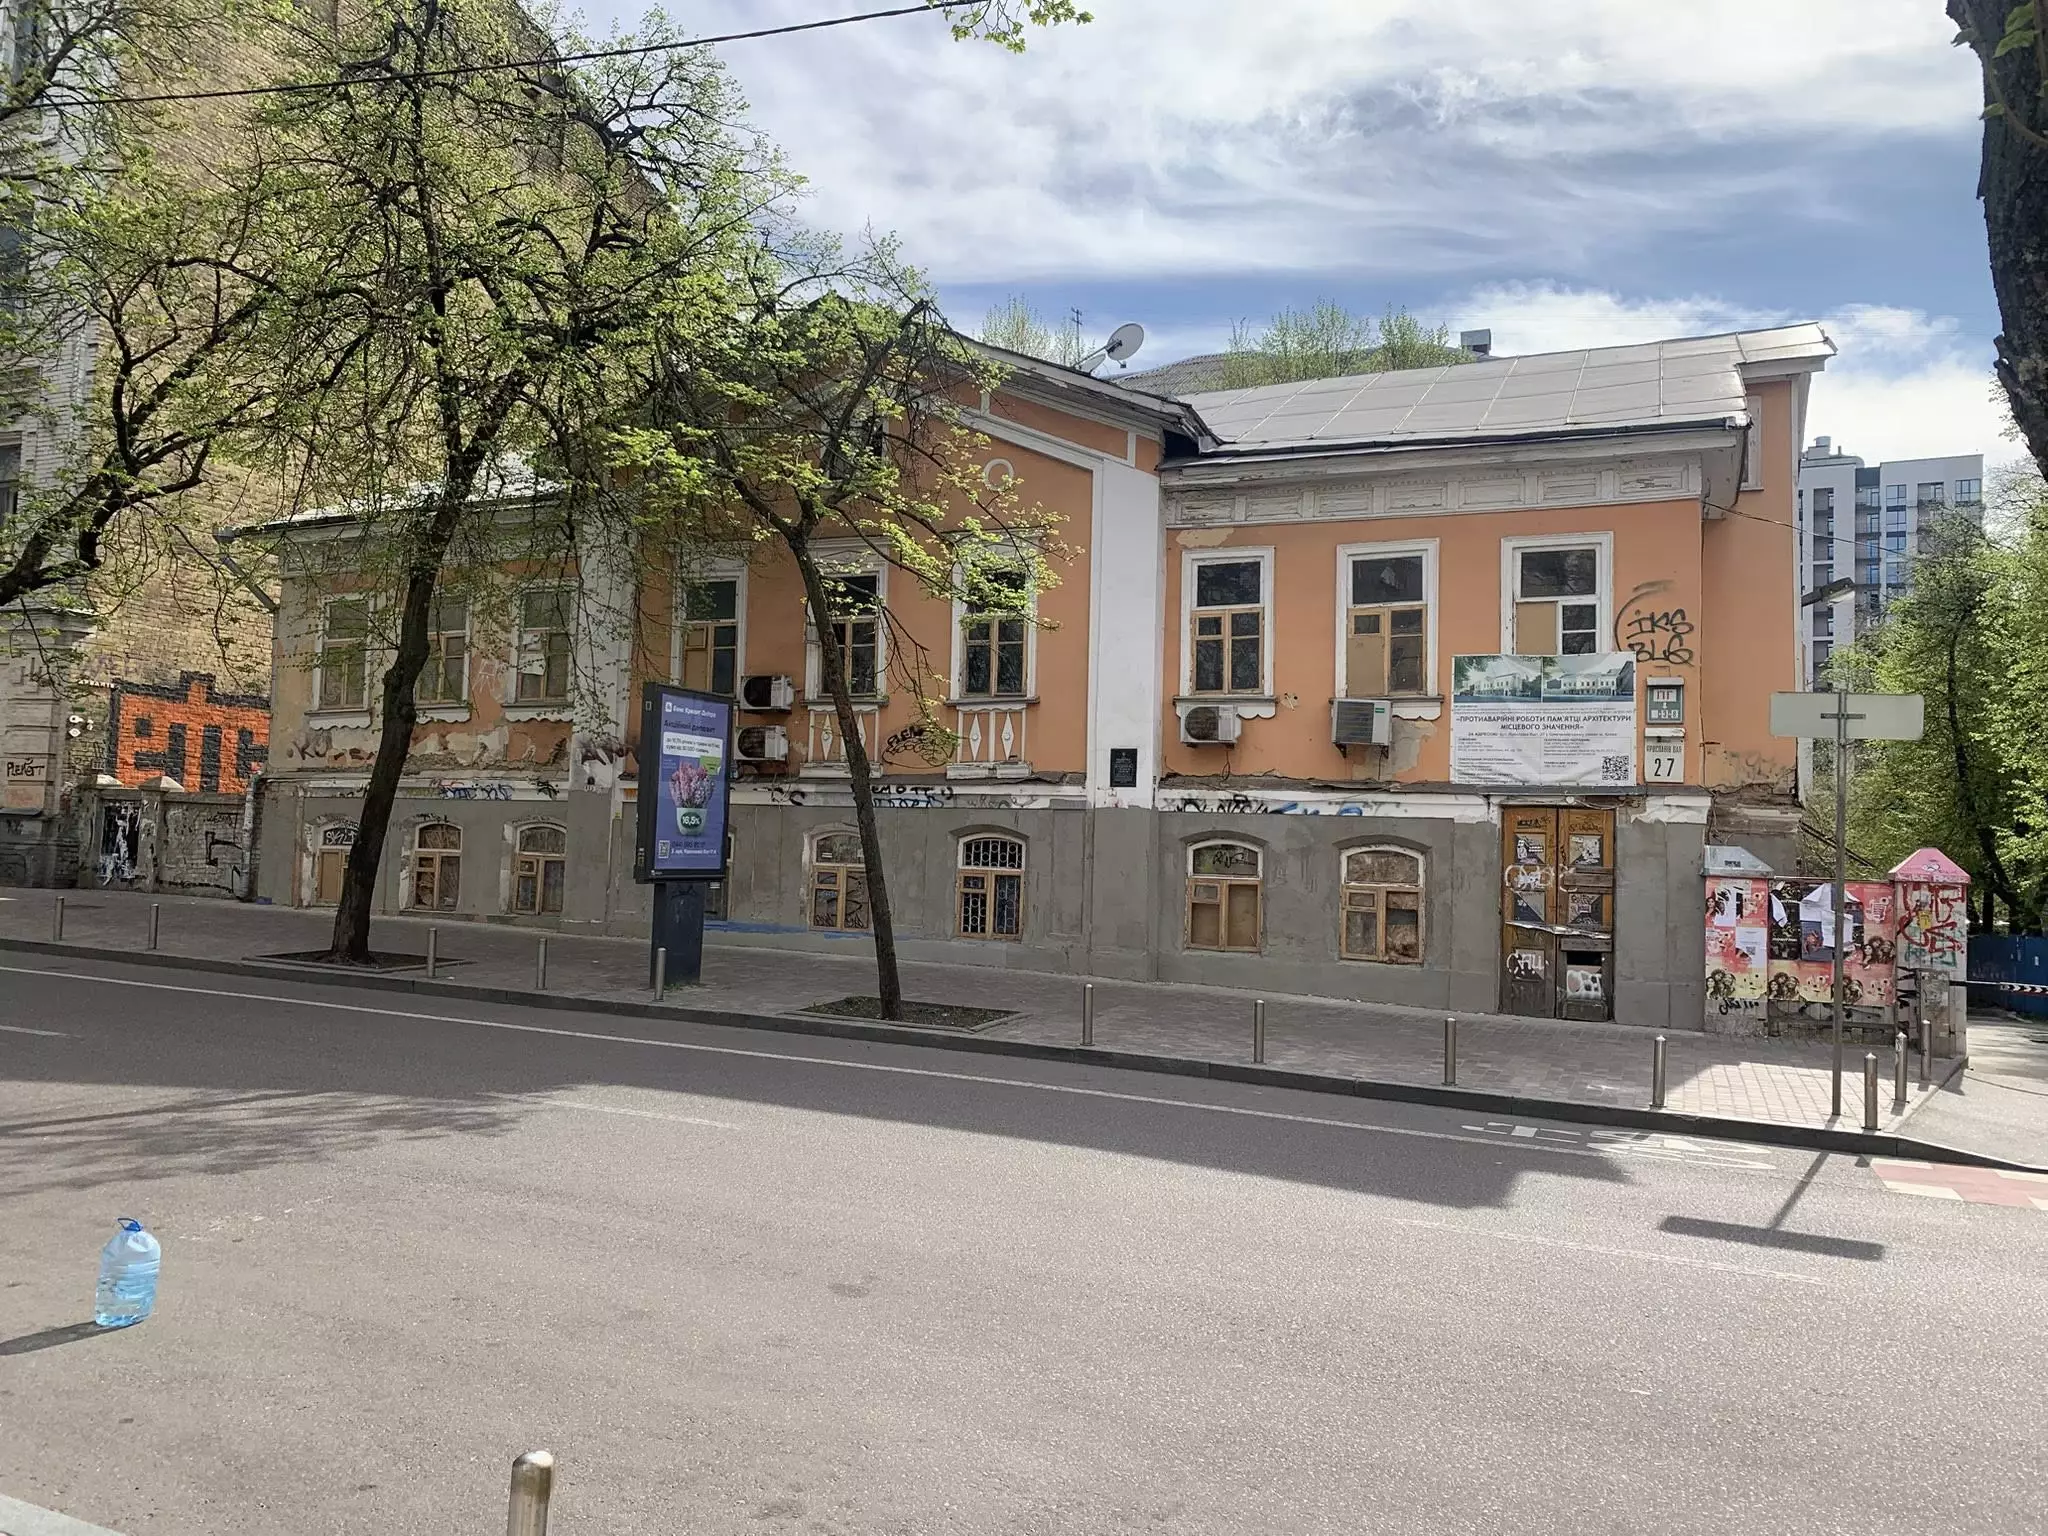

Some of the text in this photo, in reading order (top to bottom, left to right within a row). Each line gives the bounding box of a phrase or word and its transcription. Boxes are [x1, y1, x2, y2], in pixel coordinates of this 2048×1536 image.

[1516, 715, 1545, 723] РОБОТИ
[1583, 714, 1632, 722] АРХІТЕКТУРИ
[1500, 723, 1540, 731] МІСЦЕВОГО
[1654, 757, 1675, 777] 27
